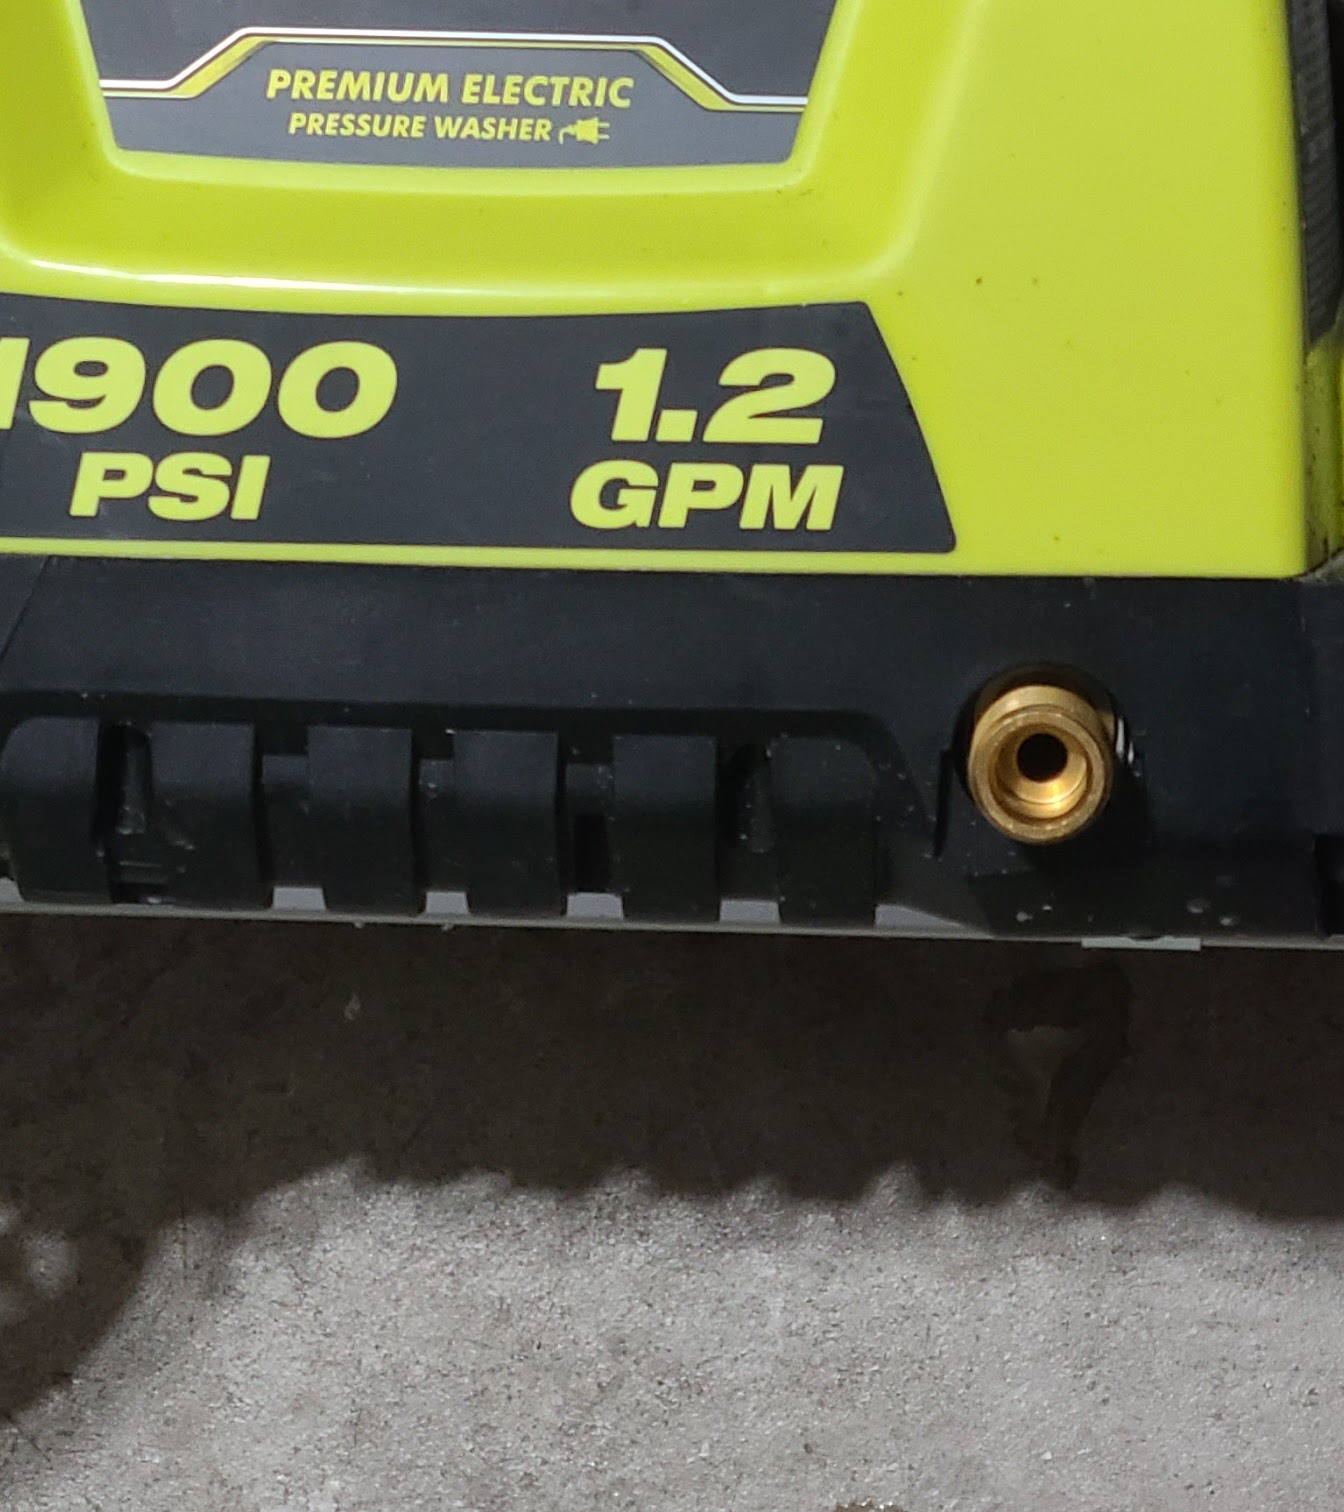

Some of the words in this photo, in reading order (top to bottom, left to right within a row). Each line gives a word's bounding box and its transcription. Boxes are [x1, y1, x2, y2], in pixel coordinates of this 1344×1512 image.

[266, 69, 450, 104] PREMIUM
[461, 73, 636, 109] ELECTRIC
[288, 112, 427, 139] PRESSURE
[435, 116, 554, 142] WASHER
[595, 347, 836, 444] 1.2
[69, 451, 271, 521] PSI
[570, 459, 844, 530] GPM
